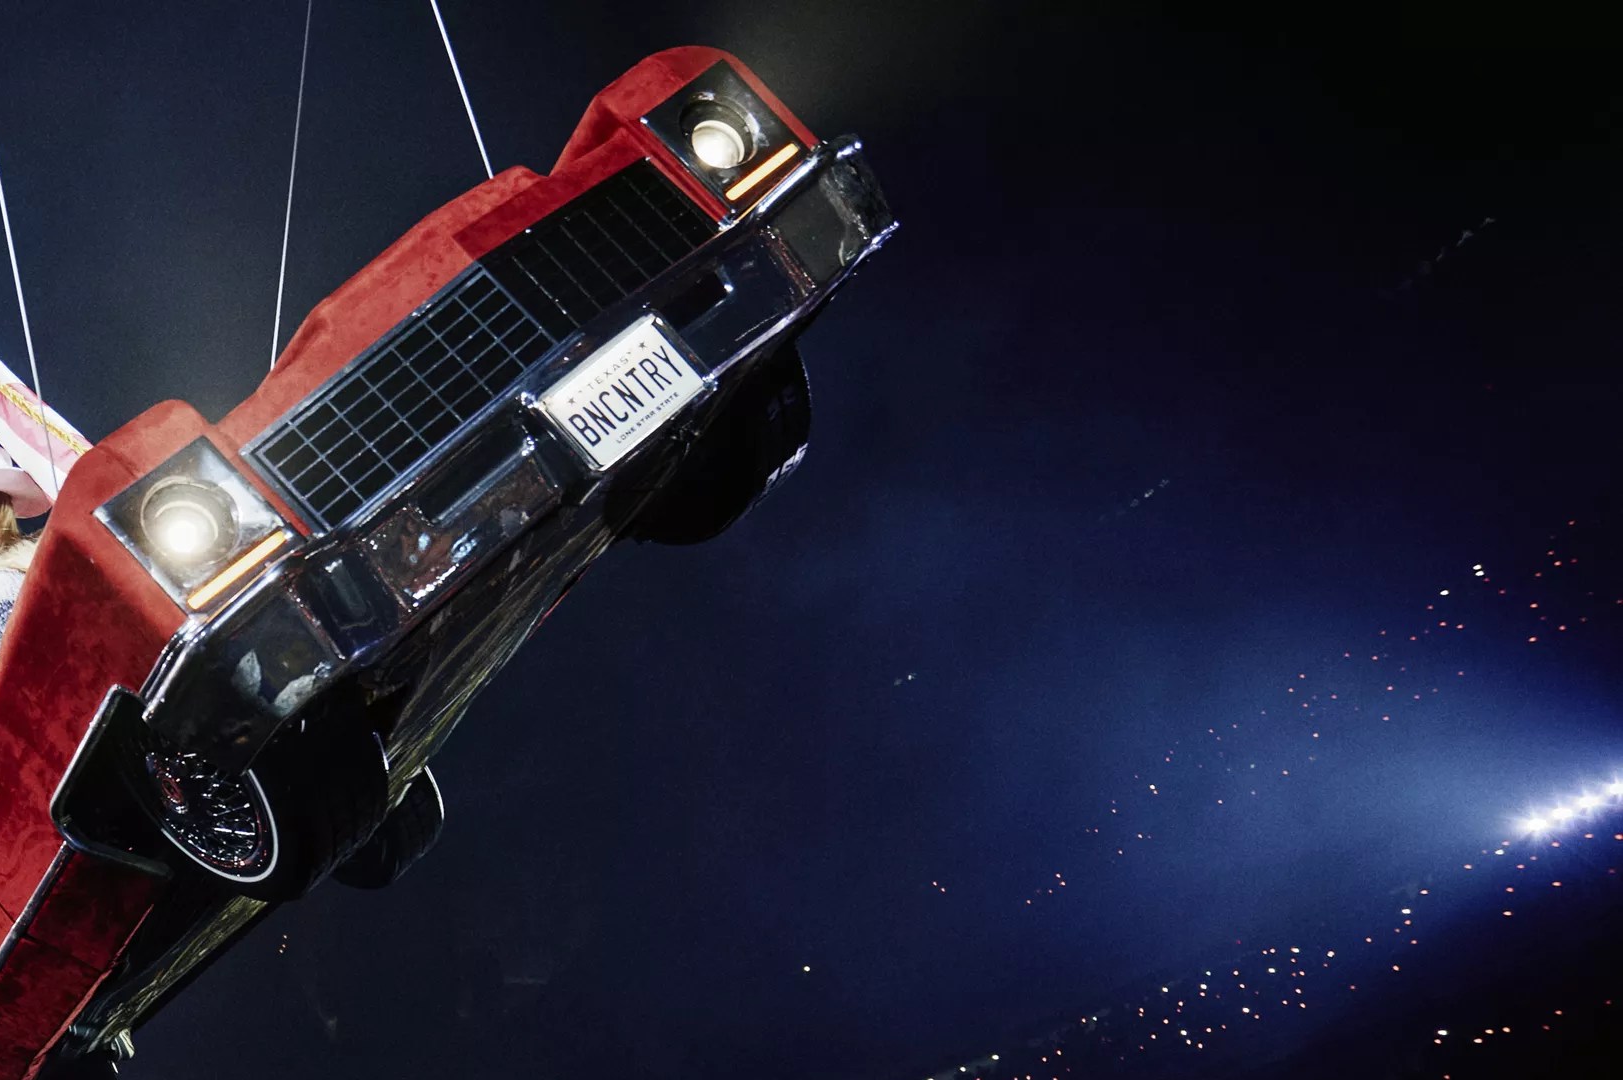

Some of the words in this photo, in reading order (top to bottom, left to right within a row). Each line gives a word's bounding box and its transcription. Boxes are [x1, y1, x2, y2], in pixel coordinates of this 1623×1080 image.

[568, 346, 683, 447] BNCNTRY
[587, 357, 630, 390] TEXAS
[617, 427, 636, 444] LONE
[636, 410, 655, 428] STAR
[656, 391, 679, 412] STATE
